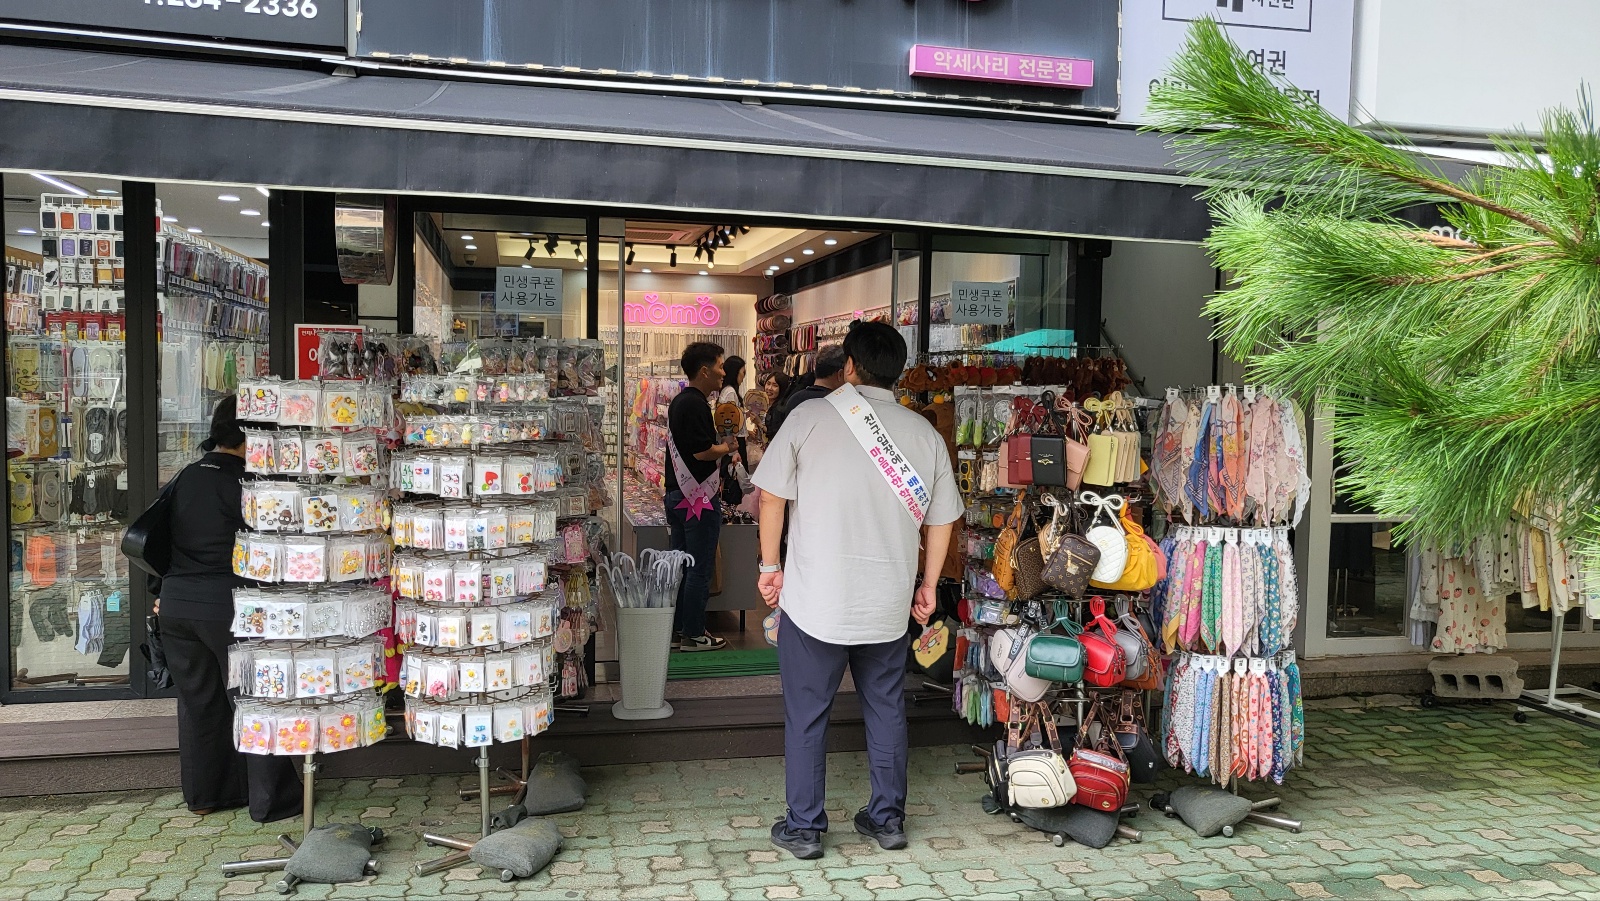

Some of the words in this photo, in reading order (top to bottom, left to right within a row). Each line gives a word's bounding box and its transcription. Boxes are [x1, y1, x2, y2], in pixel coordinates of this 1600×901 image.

[933, 51, 1009, 76] 악세사리
[1018, 57, 1073, 81] 전문점
[1246, 48, 1287, 76] 여권
[503, 275, 556, 290] 민생쿠폰
[501, 291, 557, 307] 사용가능
[958, 288, 1003, 302] 민생쿠폰
[624, 294, 720, 327] momo
[955, 303, 1004, 318] 사용가능
